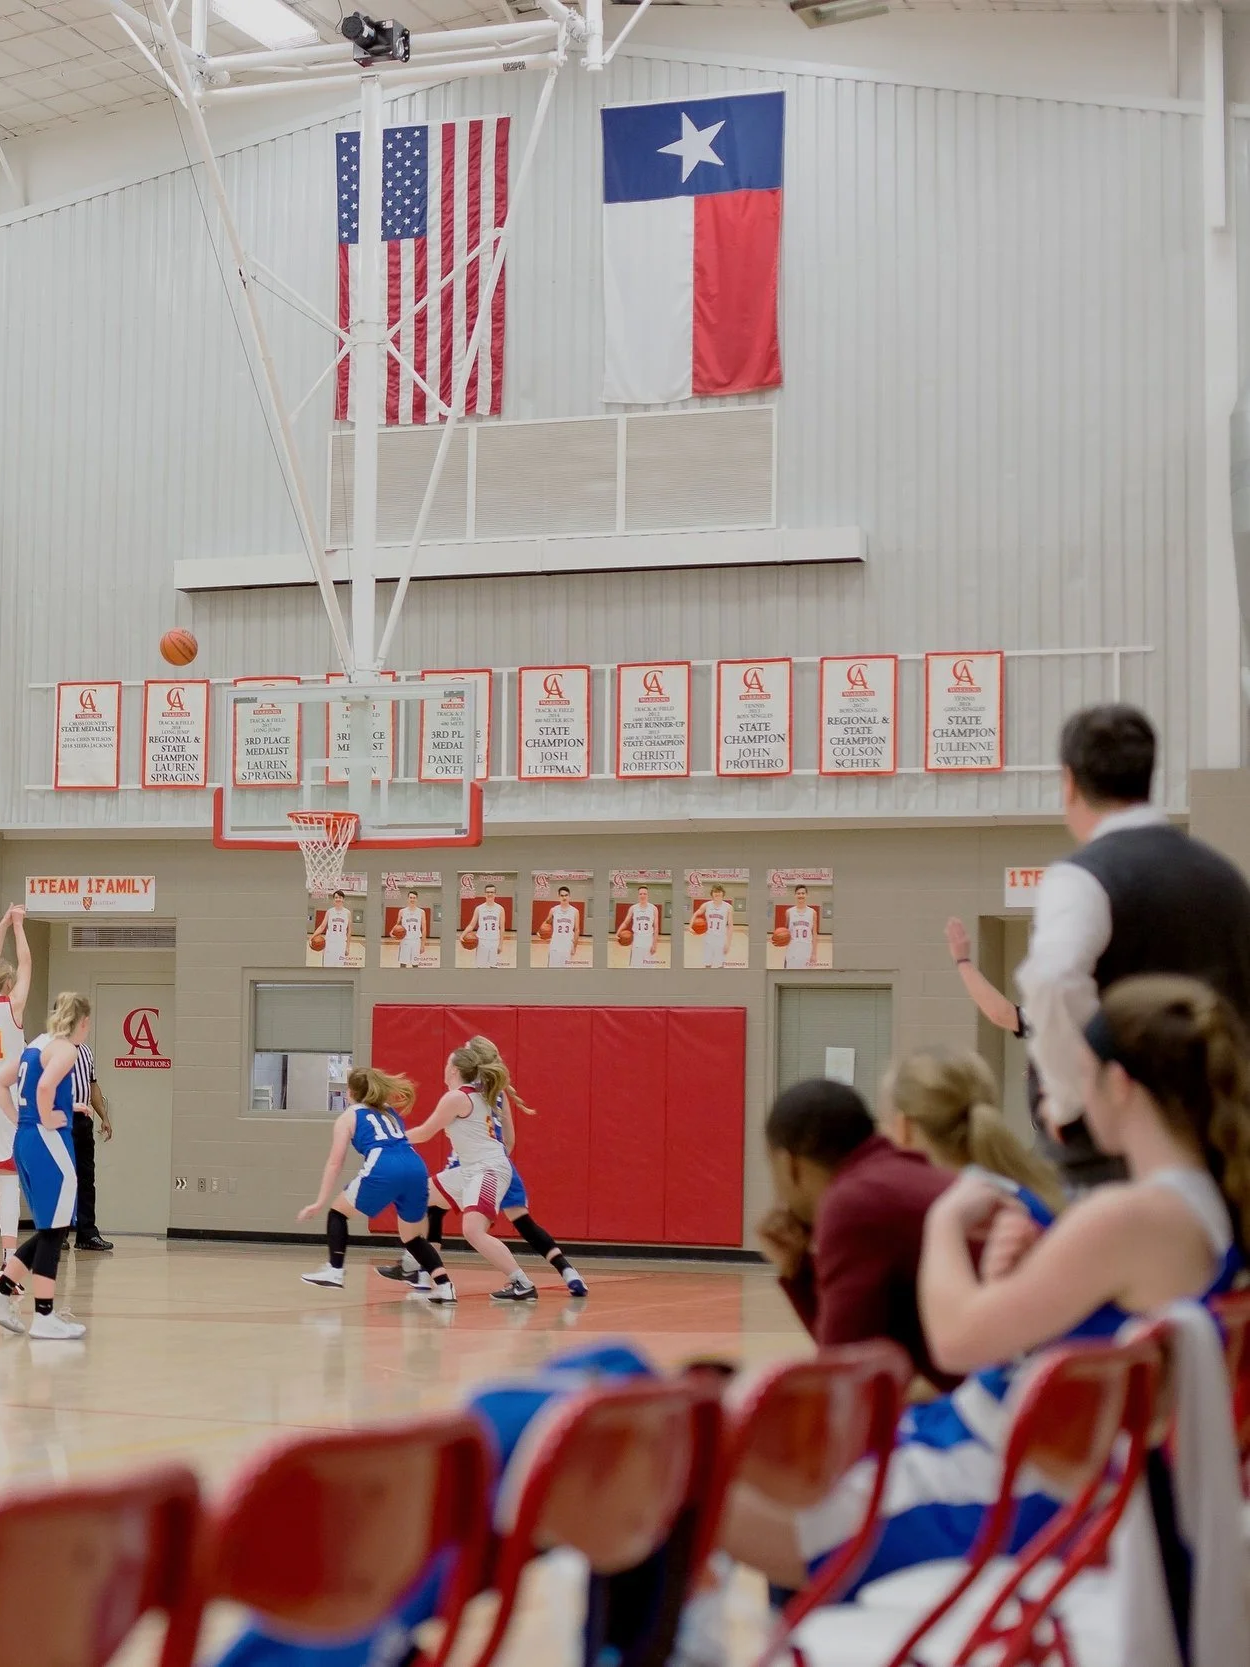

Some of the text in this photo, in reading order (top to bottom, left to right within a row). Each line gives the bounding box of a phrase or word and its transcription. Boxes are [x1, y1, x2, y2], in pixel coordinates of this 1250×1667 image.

[644, 721, 685, 729] RUNNER-UP
[827, 716, 890, 725] REGIONAL &
[947, 716, 982, 725] STATE
[539, 726, 570, 736] STATE
[739, 723, 771, 732] STATE
[843, 726, 873, 735] STATE
[431, 730, 449, 739] 3RD
[932, 728, 996, 738] CHAMPION
[244, 736, 290, 746] 3RD PLACE
[525, 738, 584, 748] CHAMPION
[724, 734, 786, 744] CHAMPION
[830, 736, 886, 745] CHAMPION
[246, 747, 289, 756] MEDALIST
[832, 747, 883, 756] COLSON
[934, 741, 994, 754] JULIENNE
[151, 754, 198, 762] CHAMPION
[540, 752, 568, 763] JOSH
[632, 751, 675, 760] CHRISTI
[738, 748, 770, 760] JOHN
[247, 760, 287, 770] LAUREN
[726, 758, 784, 769] PROTHRO
[835, 759, 881, 768] SCHIEK
[936, 756, 993, 766] SWEENEY
[155, 763, 195, 772] LAUREN
[528, 765, 582, 774] LUFFMAN
[622, 761, 685, 771] ROBERTSON
[150, 773, 200, 782] SPRAGINS
[241, 771, 292, 780] SPRAGINS
[333, 924, 342, 932] 21
[558, 925, 569, 933] 23
[638, 923, 648, 931] 13
[795, 929, 807, 938] 10
[123, 1007, 163, 1055] CA
[365, 1113, 404, 1141] 10
